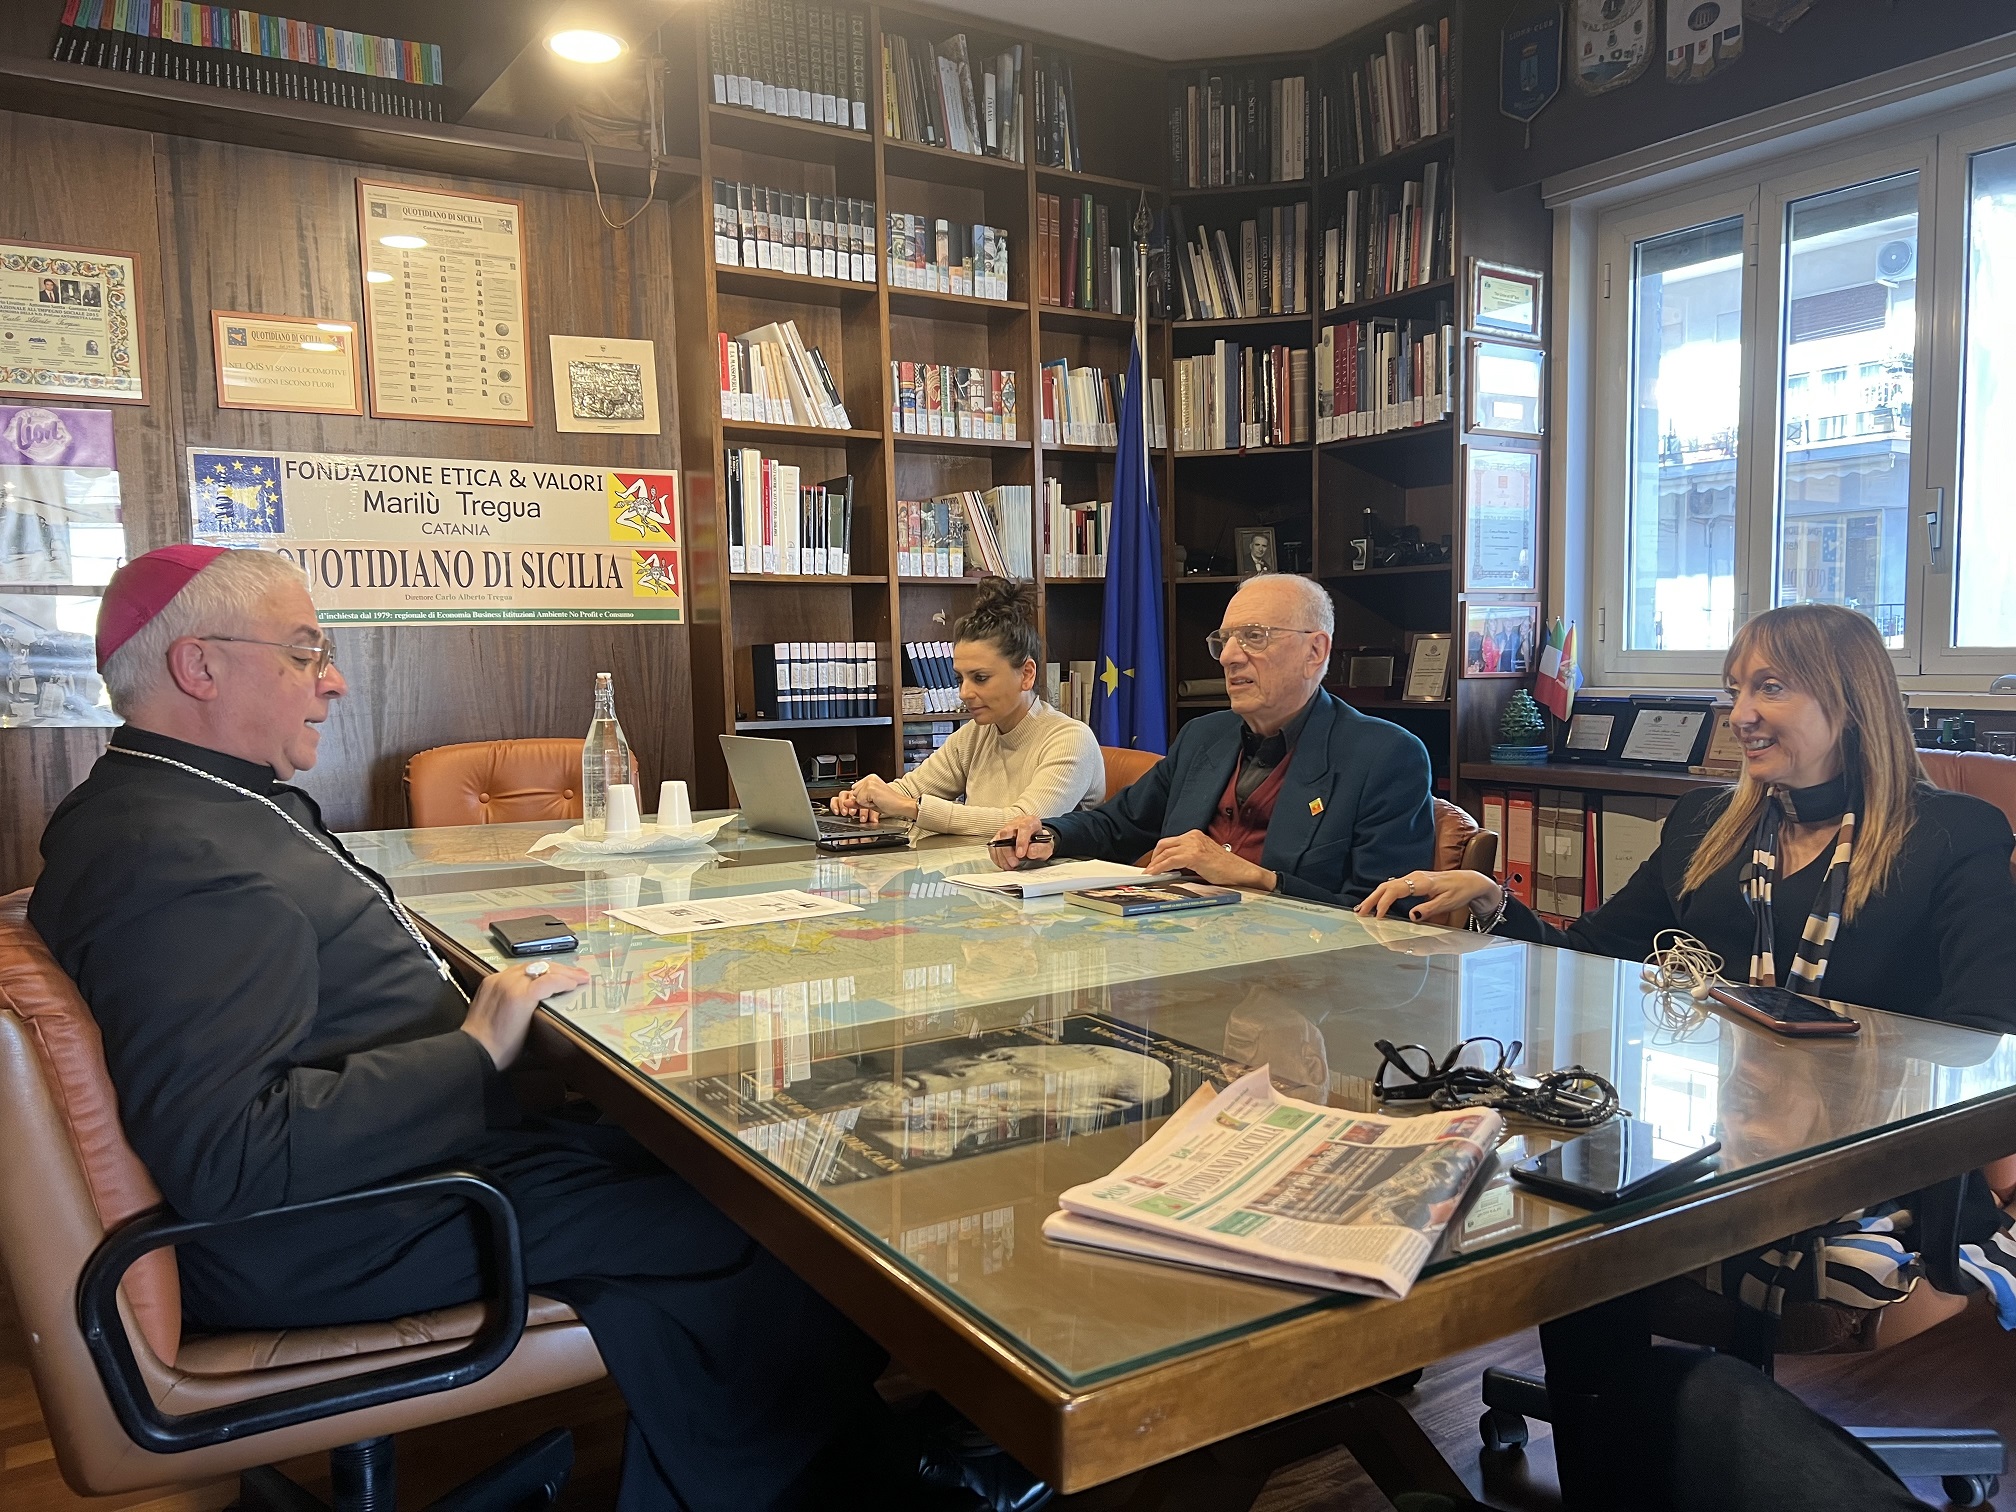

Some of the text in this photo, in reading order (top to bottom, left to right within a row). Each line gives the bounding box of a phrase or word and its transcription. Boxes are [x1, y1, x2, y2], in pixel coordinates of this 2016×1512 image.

[402, 206, 447, 220] QUOTIDIANO
[456, 214, 482, 224] SICILIA
[1245, 237, 1254, 301] BRUNO CARUSO
[251, 330, 322, 343] QUOTIDIANO DI SICILIA
[246, 361, 264, 371] QdS
[275, 365, 297, 373] SONO
[298, 367, 347, 376] LOCOMOTIVE
[280, 378, 311, 387] ESCONO
[285, 460, 604, 492] FONDAZIONE ETICA & VALORI
[363, 489, 541, 523] Marilù Tregua
[421, 522, 491, 536] CATANIA
[482, 550, 514, 589] DI
[521, 550, 624, 590] SICILIA
[435, 593, 456, 601] Carlo
[458, 593, 486, 601] Alberto
[488, 593, 513, 602] Tregua
[318, 611, 358, 620] d'inchiesta
[360, 611, 372, 619] dal
[373, 611, 393, 620] 1979:
[394, 612, 427, 621] regionale
[427, 611, 436, 619] di
[436, 611, 472, 619] Economia
[472, 611, 502, 619] Business
[502, 611, 536, 619] Istituzioni
[536, 611, 568, 619] Ambiente
[569, 611, 579, 619] No
[580, 611, 599, 619] Profit
[604, 611, 634, 620] Consumo
[1163, 1157, 1243, 1200] QUOTIDIANO
[1233, 1125, 1285, 1153] SICILIA
